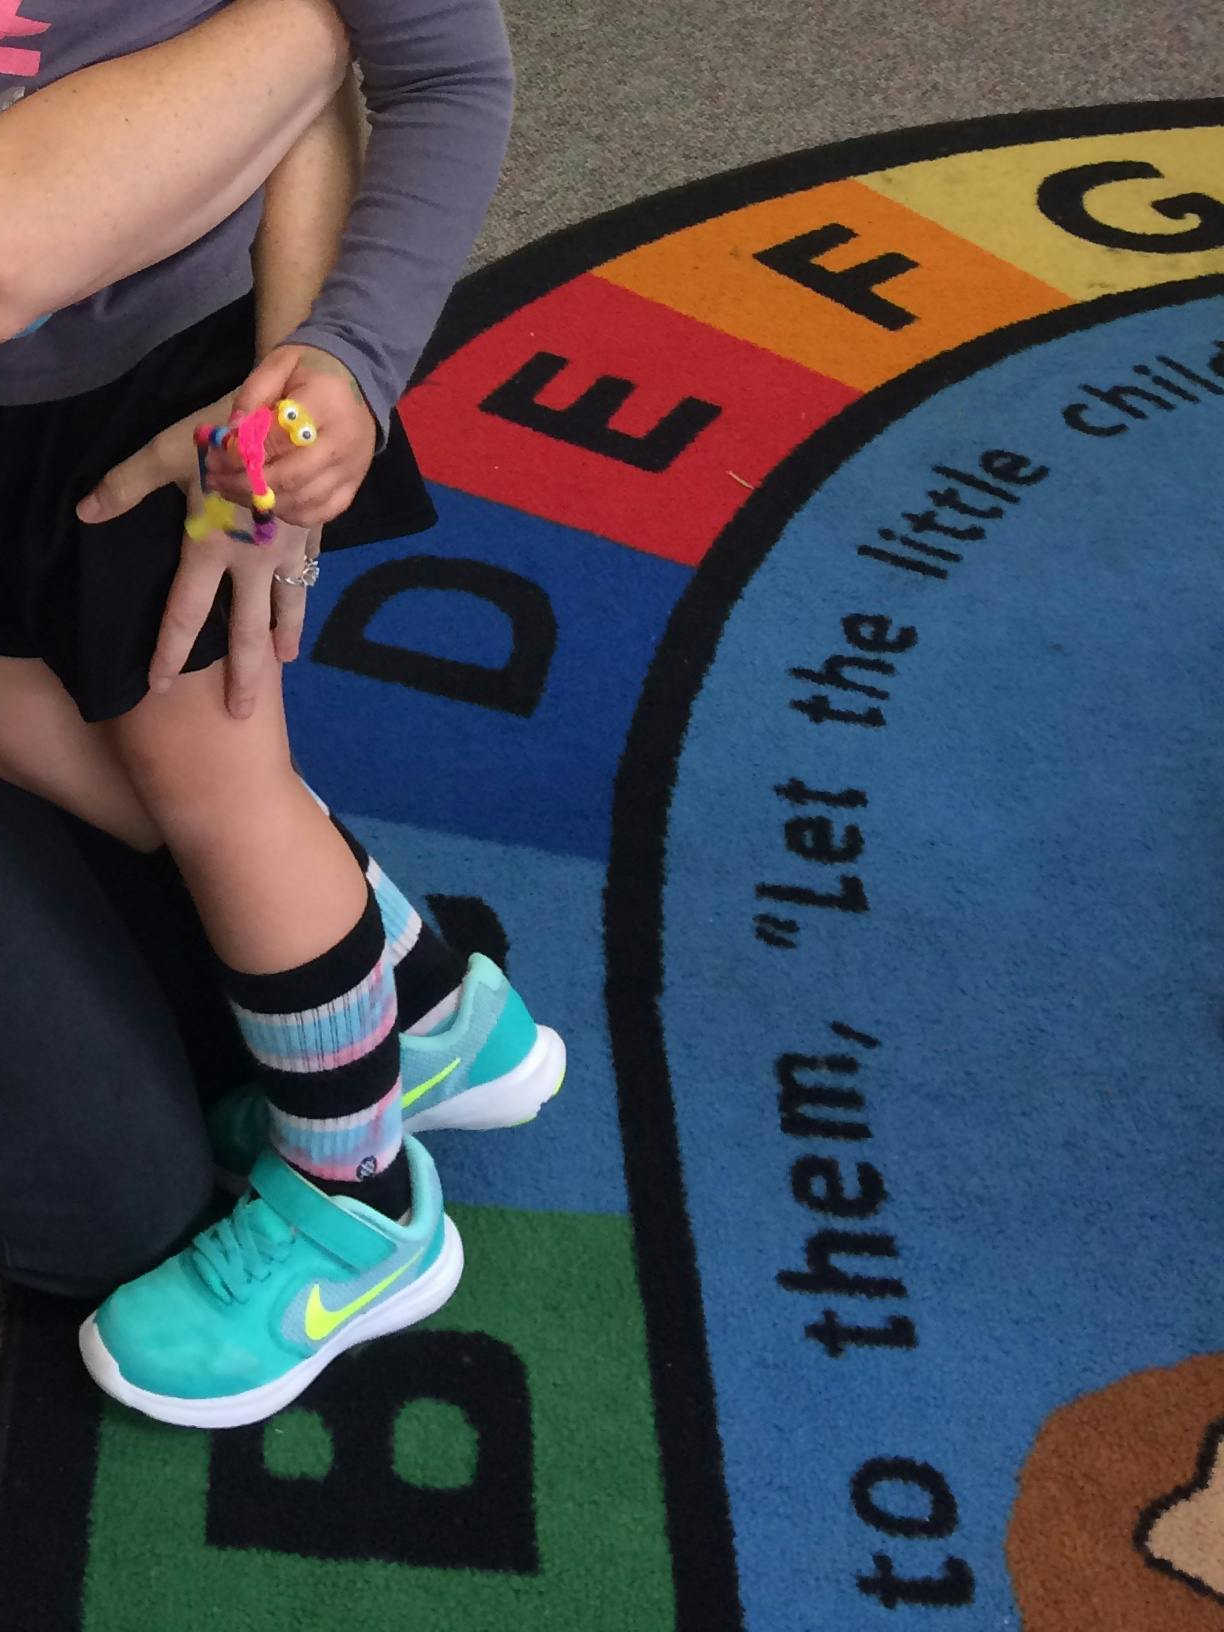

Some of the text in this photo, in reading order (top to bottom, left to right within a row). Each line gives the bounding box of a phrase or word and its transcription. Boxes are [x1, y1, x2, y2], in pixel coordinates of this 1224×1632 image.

[1036, 160, 1224, 254] G
[753, 223, 921, 331] F
[478, 351, 723, 473] E
[857, 449, 1050, 580] little
[310, 555, 558, 718] D
[790, 612, 918, 728] the
[775, 1021, 918, 1359] them,
[205, 1328, 540, 1577] B
[850, 1455, 975, 1609] to
